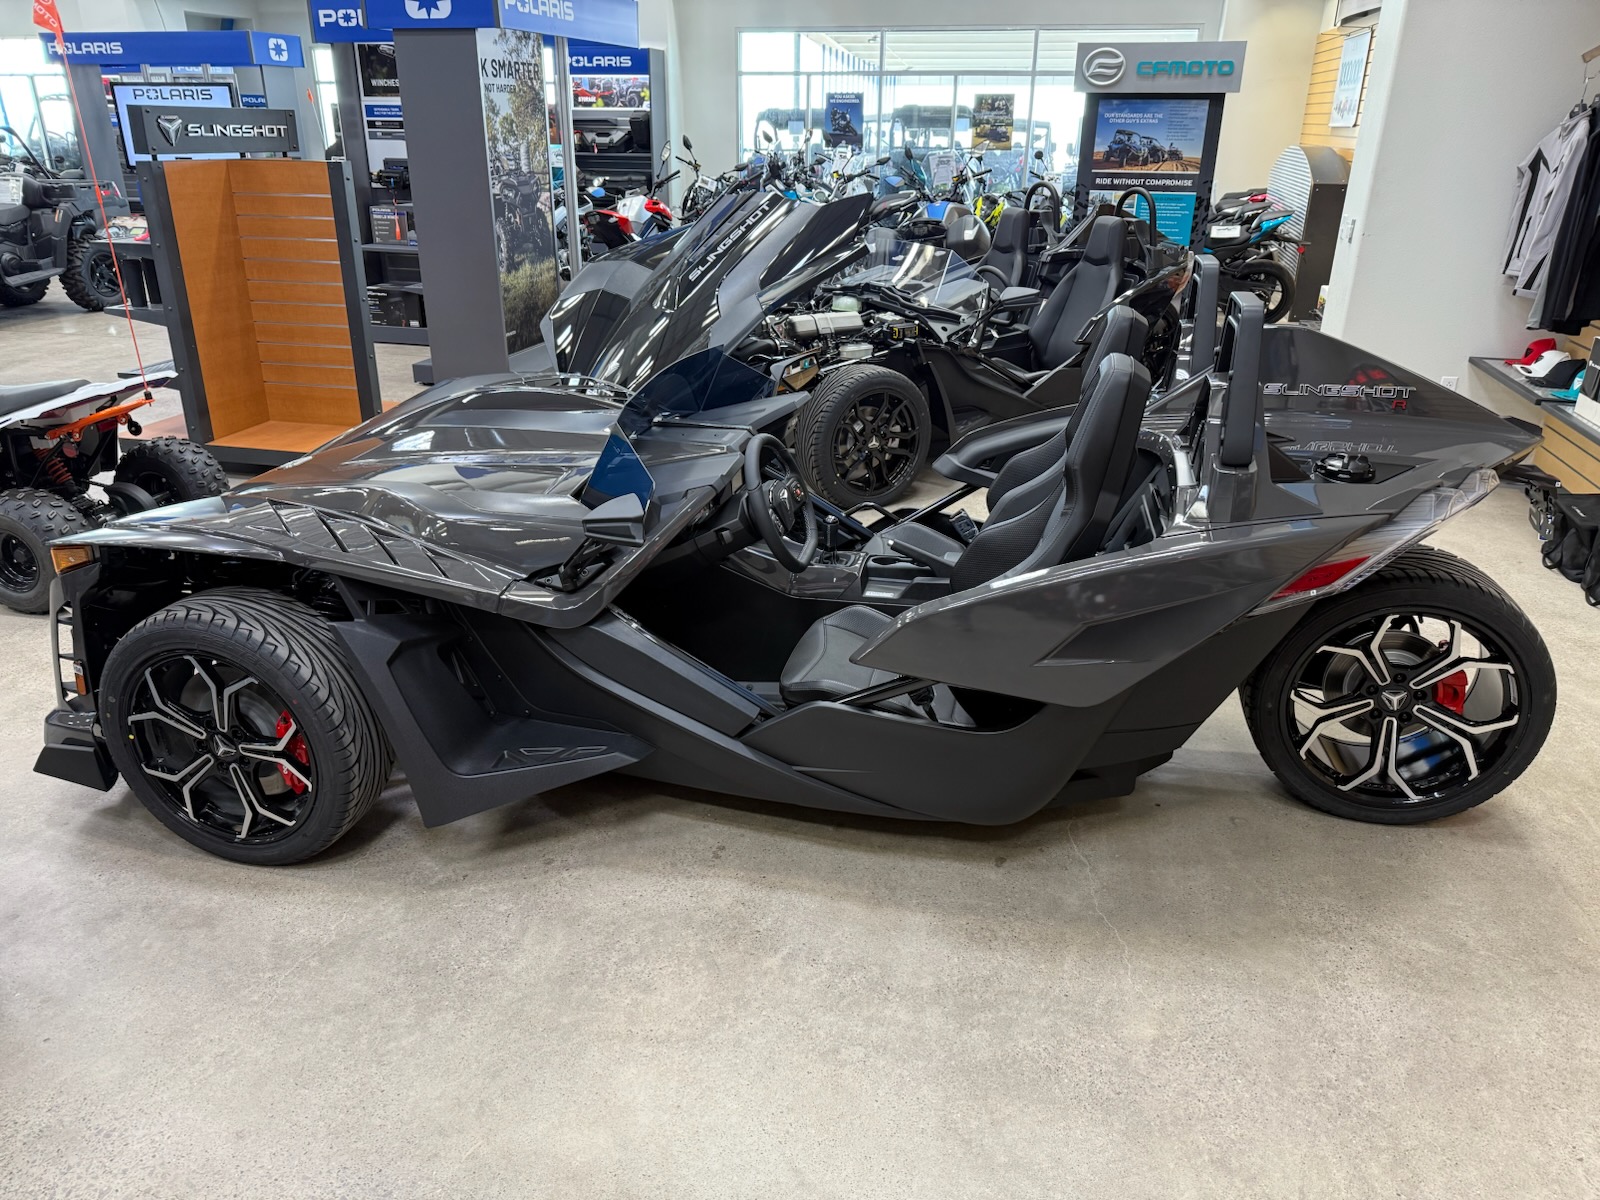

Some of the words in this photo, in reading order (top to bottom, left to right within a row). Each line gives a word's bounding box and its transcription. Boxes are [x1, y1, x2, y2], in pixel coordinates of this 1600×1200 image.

[491, 58, 540, 80] SMARTER
[1136, 60, 1235, 76] CFMOTO
[133, 88, 213, 101] POLARIS
[484, 83, 495, 93] NOT
[187, 123, 288, 138] SLINGSHOT
[1095, 177, 1112, 185] RIDE
[1113, 178, 1145, 186] WITHOUT
[1145, 179, 1193, 187] COMPROMISE
[688, 201, 770, 282] SLINGSHOT
[1263, 382, 1417, 398] SLINGSHOT
[1391, 399, 1407, 410] R
